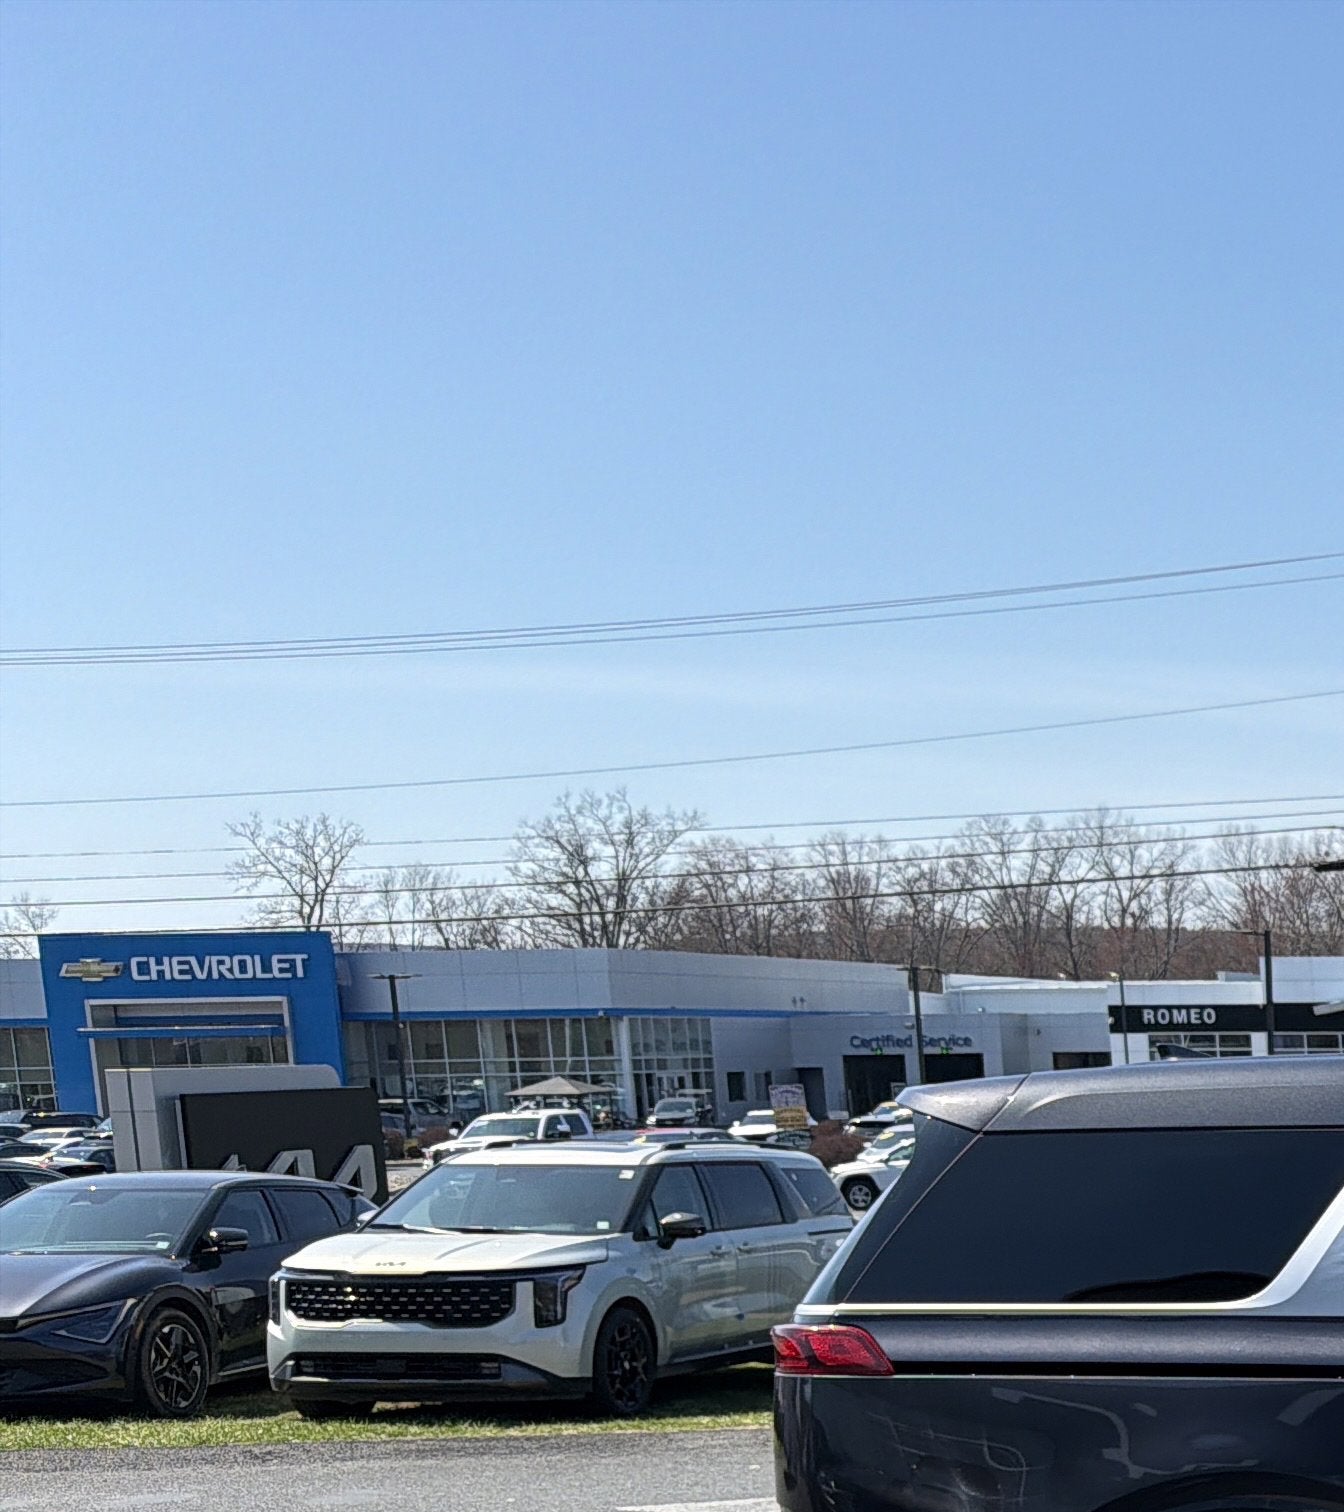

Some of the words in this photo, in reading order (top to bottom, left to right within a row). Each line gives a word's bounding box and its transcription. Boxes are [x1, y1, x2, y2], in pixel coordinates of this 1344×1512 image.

[130, 954, 309, 981] CHEVROLET
[1143, 1008, 1216, 1024] ROMEO
[850, 1035, 913, 1048] Certified
[920, 1034, 972, 1047] Service
